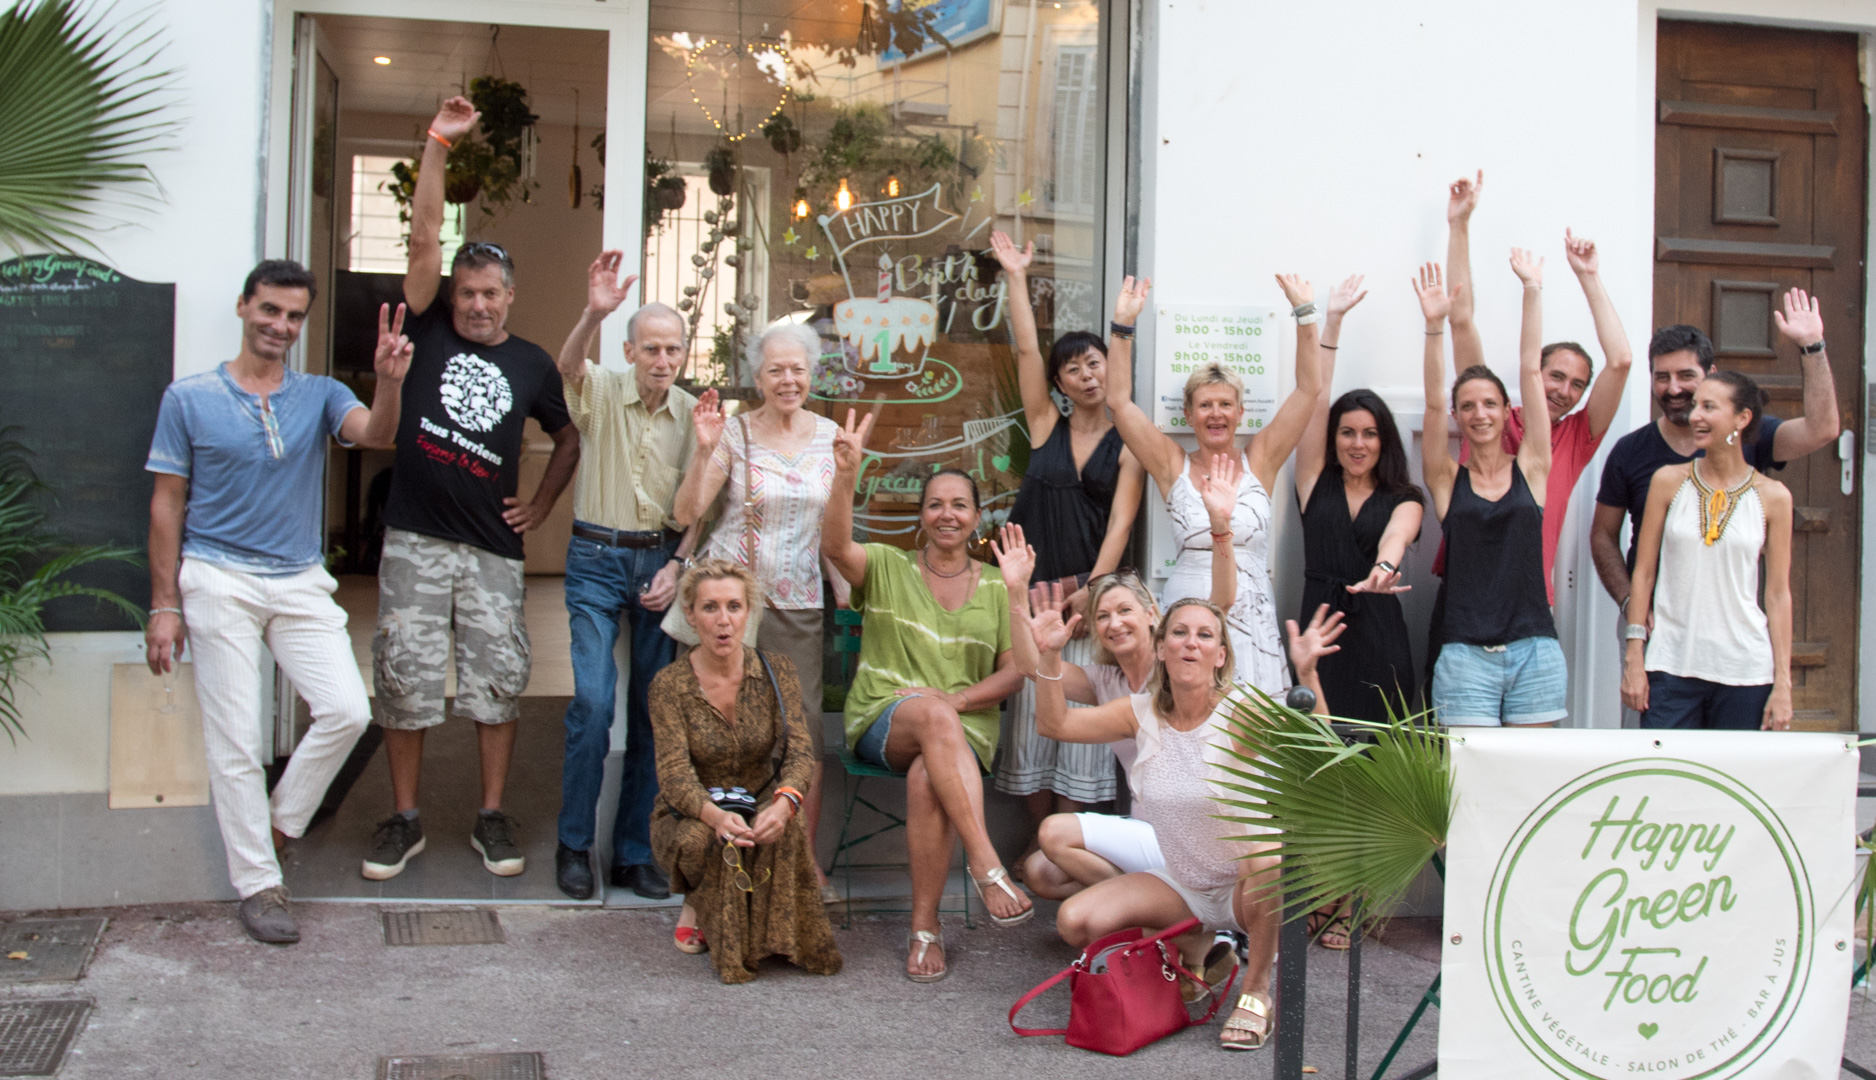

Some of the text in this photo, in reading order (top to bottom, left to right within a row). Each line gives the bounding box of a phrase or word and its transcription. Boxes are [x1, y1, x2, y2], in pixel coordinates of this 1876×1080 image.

[843, 201, 920, 240] HAPPY
[896, 252, 979, 291] Birth
[956, 281, 1009, 331] day
[1174, 314, 1262, 324] Du Lundi au Jeudi
[1175, 325, 1209, 334] 9h00
[1224, 326, 1262, 336] 15h00
[1188, 341, 1248, 350] Le Vendredi
[1174, 352, 1208, 361] 9h00
[1224, 353, 1262, 362] 15h00
[1248, 418, 1262, 428] 86
[420, 417, 503, 466] Tous Terriens
[853, 454, 922, 511] Green
[1580, 795, 1736, 872] Happy
[1565, 867, 1737, 977] Green
[1772, 937, 1787, 968] JUS
[1511, 939, 1542, 1010] CANTINE
[1603, 947, 1708, 1012] Food
[1767, 974, 1778, 990] À
[1746, 990, 1771, 1020] BAR
[1541, 1011, 1609, 1068] VÉGÉTALE
[1710, 1026, 1739, 1052] THÉ
[1627, 1057, 1679, 1073] SALON
[1686, 1050, 1707, 1064] DE
